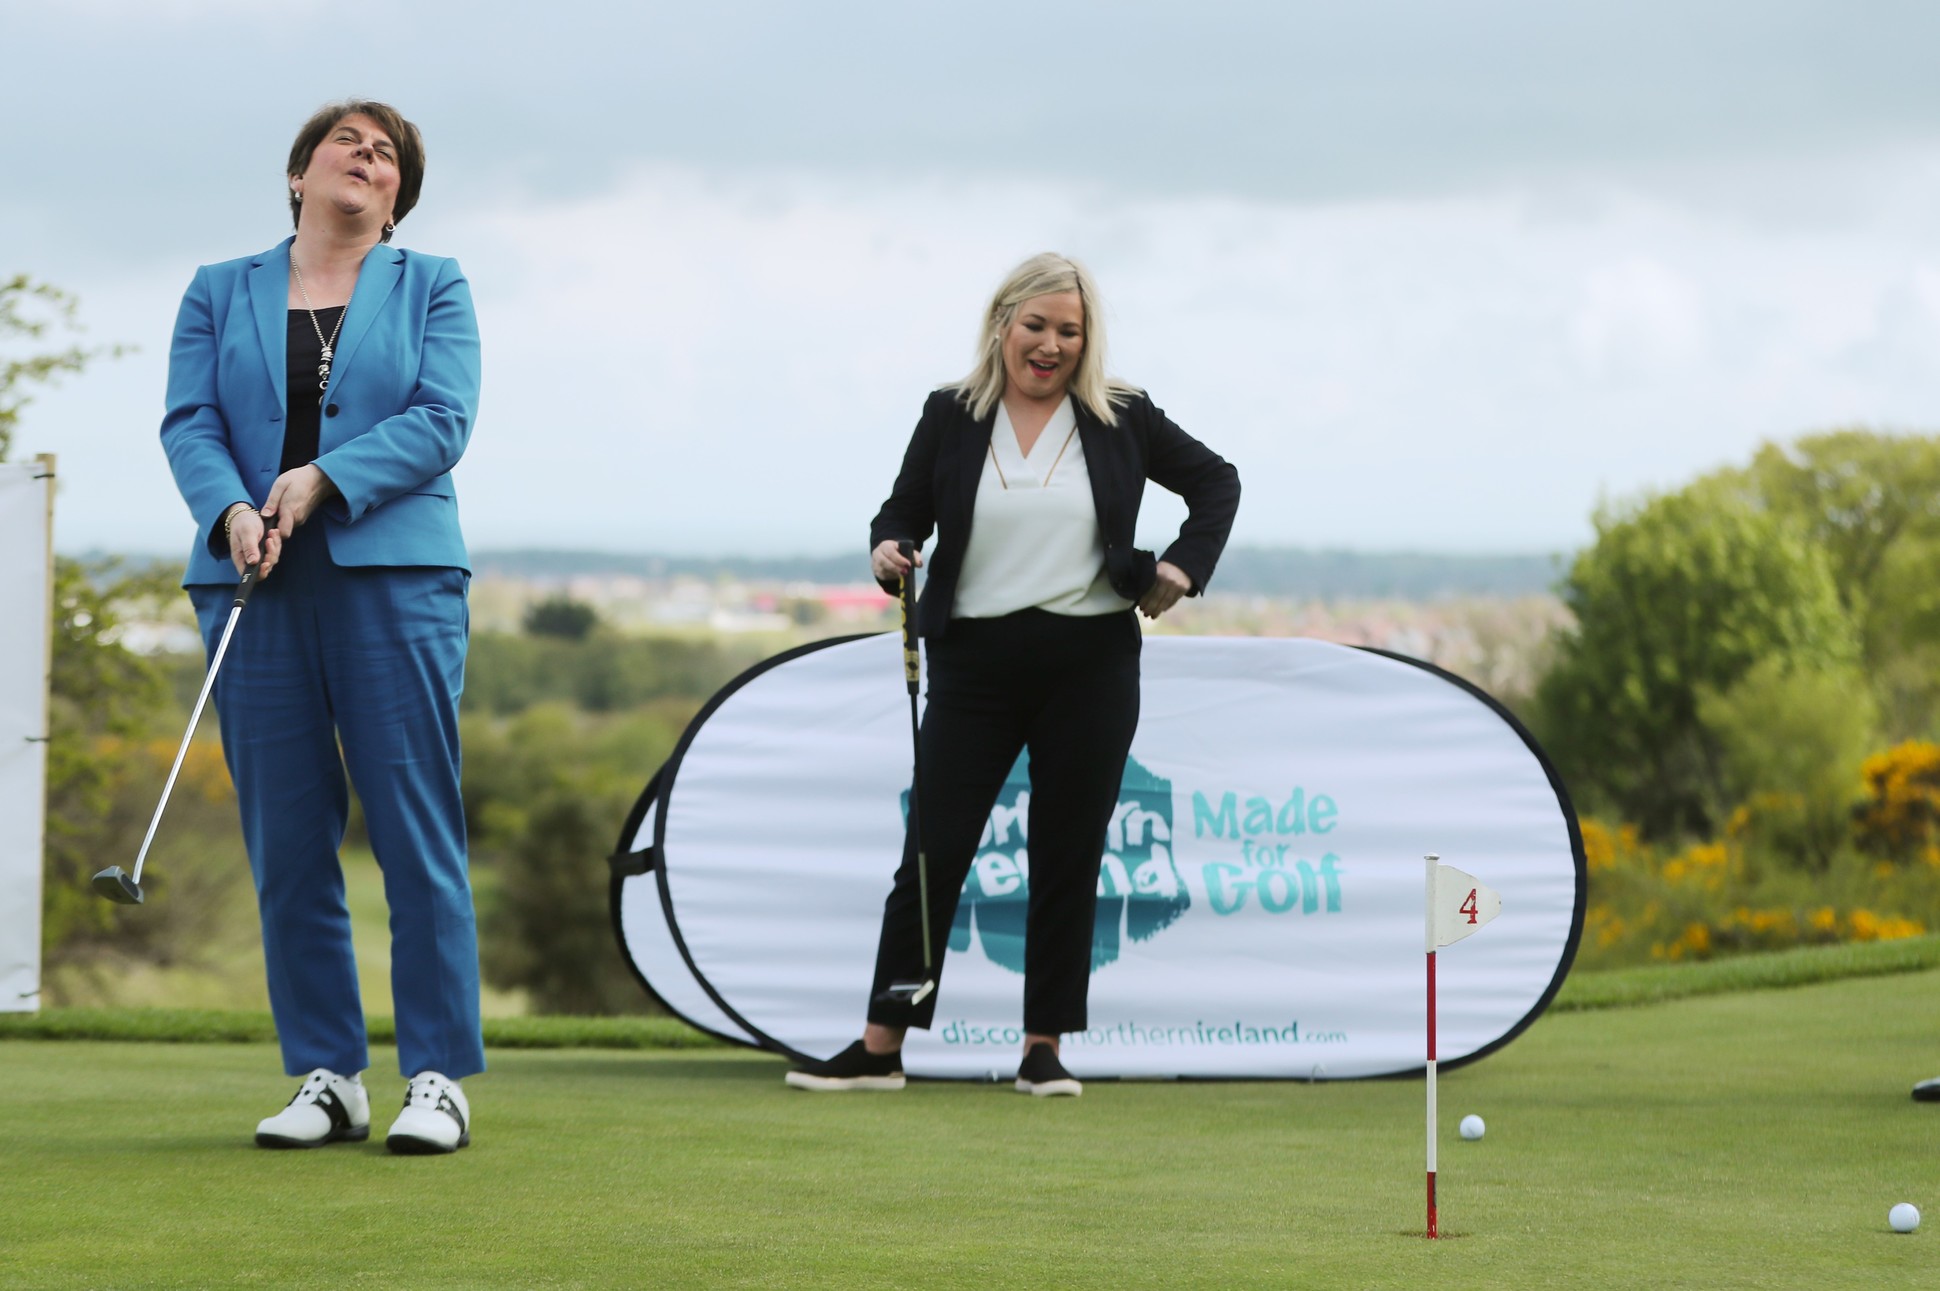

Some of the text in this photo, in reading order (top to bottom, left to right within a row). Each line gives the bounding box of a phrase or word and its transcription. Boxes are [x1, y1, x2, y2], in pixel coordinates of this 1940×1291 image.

[1192, 786, 1338, 840] Made
[1241, 839, 1291, 868] for
[1202, 852, 1346, 916] Golf
[1459, 888, 1478, 924] 4
